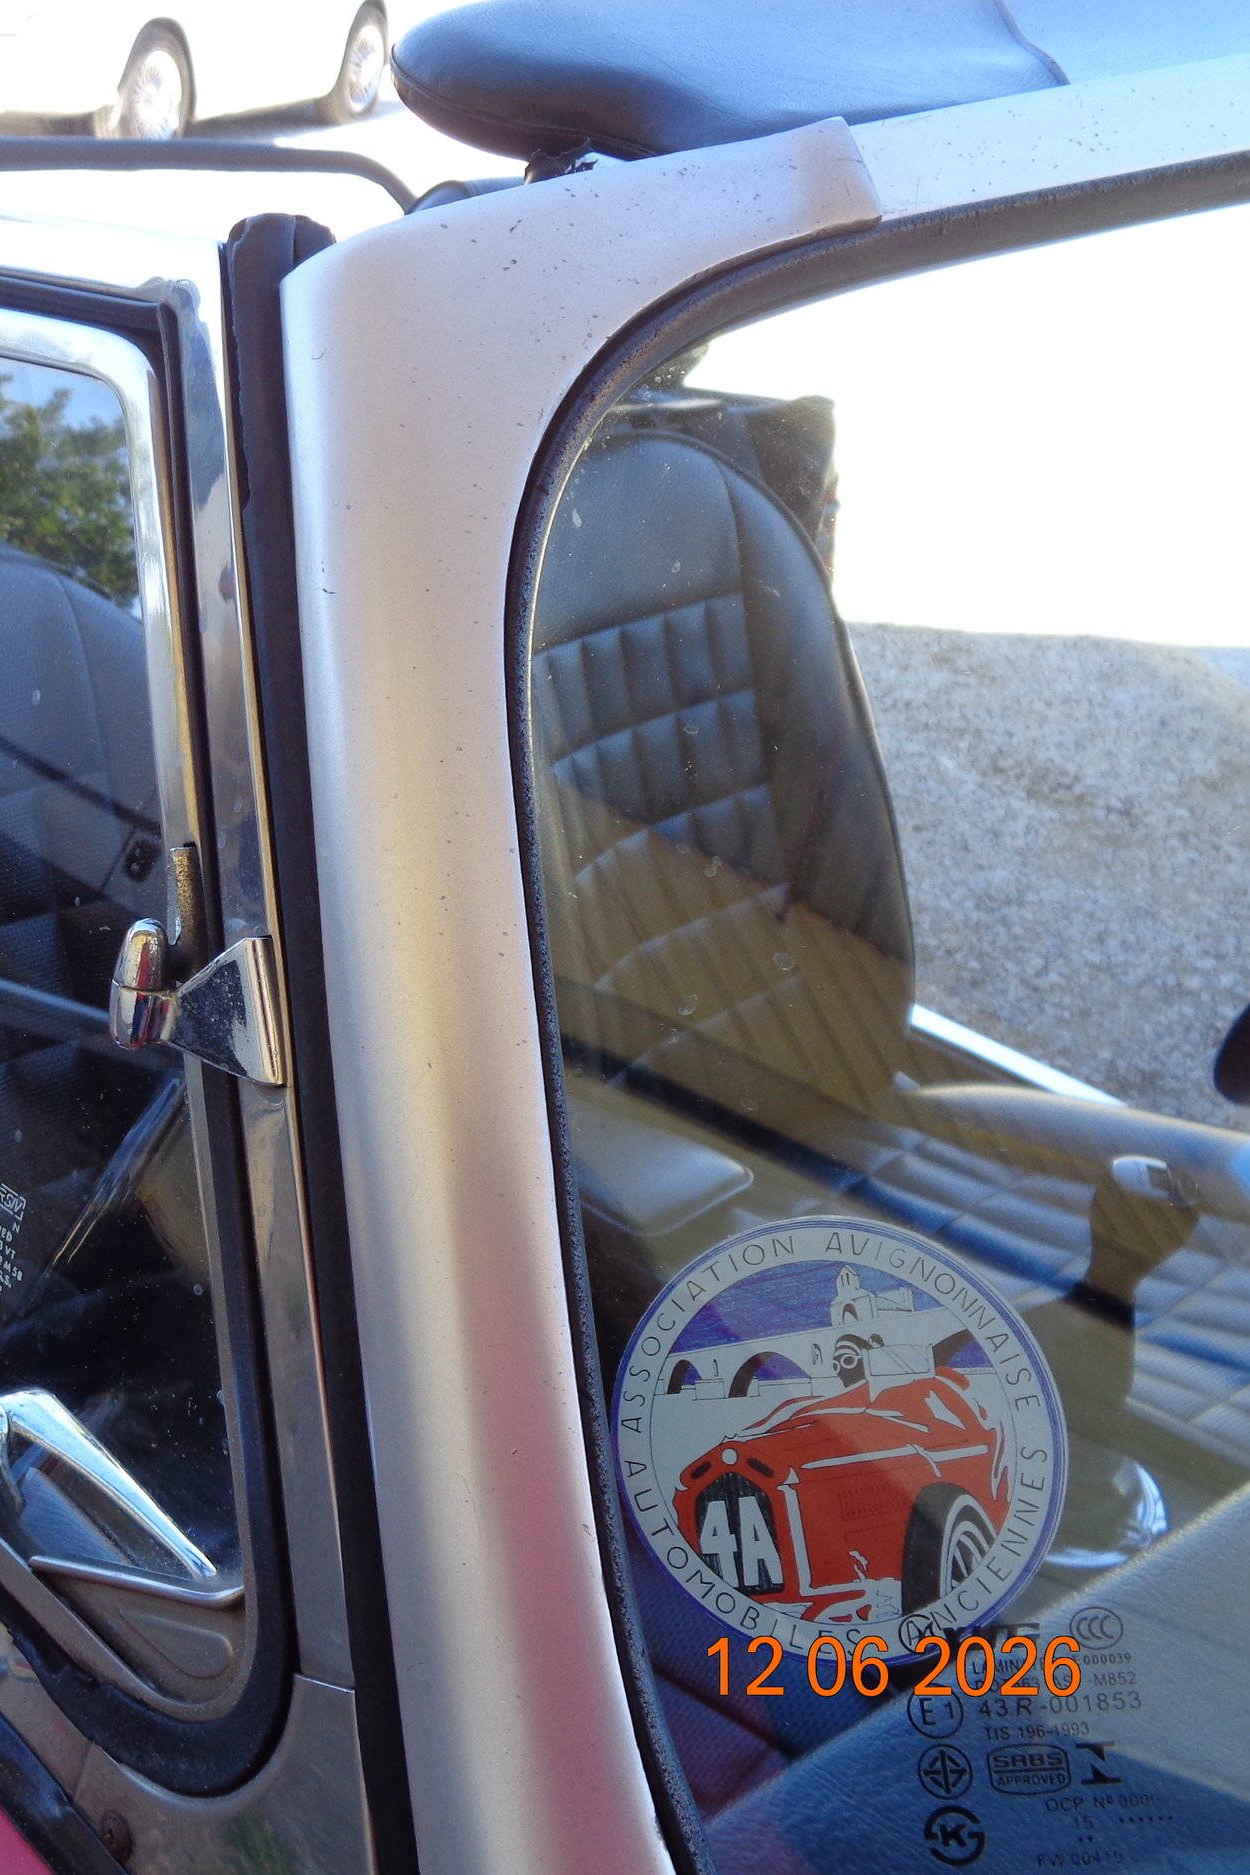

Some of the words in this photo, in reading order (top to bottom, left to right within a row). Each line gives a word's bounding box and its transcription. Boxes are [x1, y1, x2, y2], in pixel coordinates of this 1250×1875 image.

[12, 1221, 20, 1233] N
[620, 1235, 795, 1434] ASSOCIATION
[824, 1231, 1041, 1412] AVIGNONNAISE
[699, 1496, 784, 1589] 4A
[1093, 1671, 1136, 1688] M852
[984, 1726, 1011, 1741] TIS
[1018, 1722, 1090, 1739] 196-1993
[997, 1772, 1066, 1787] APPROVED
